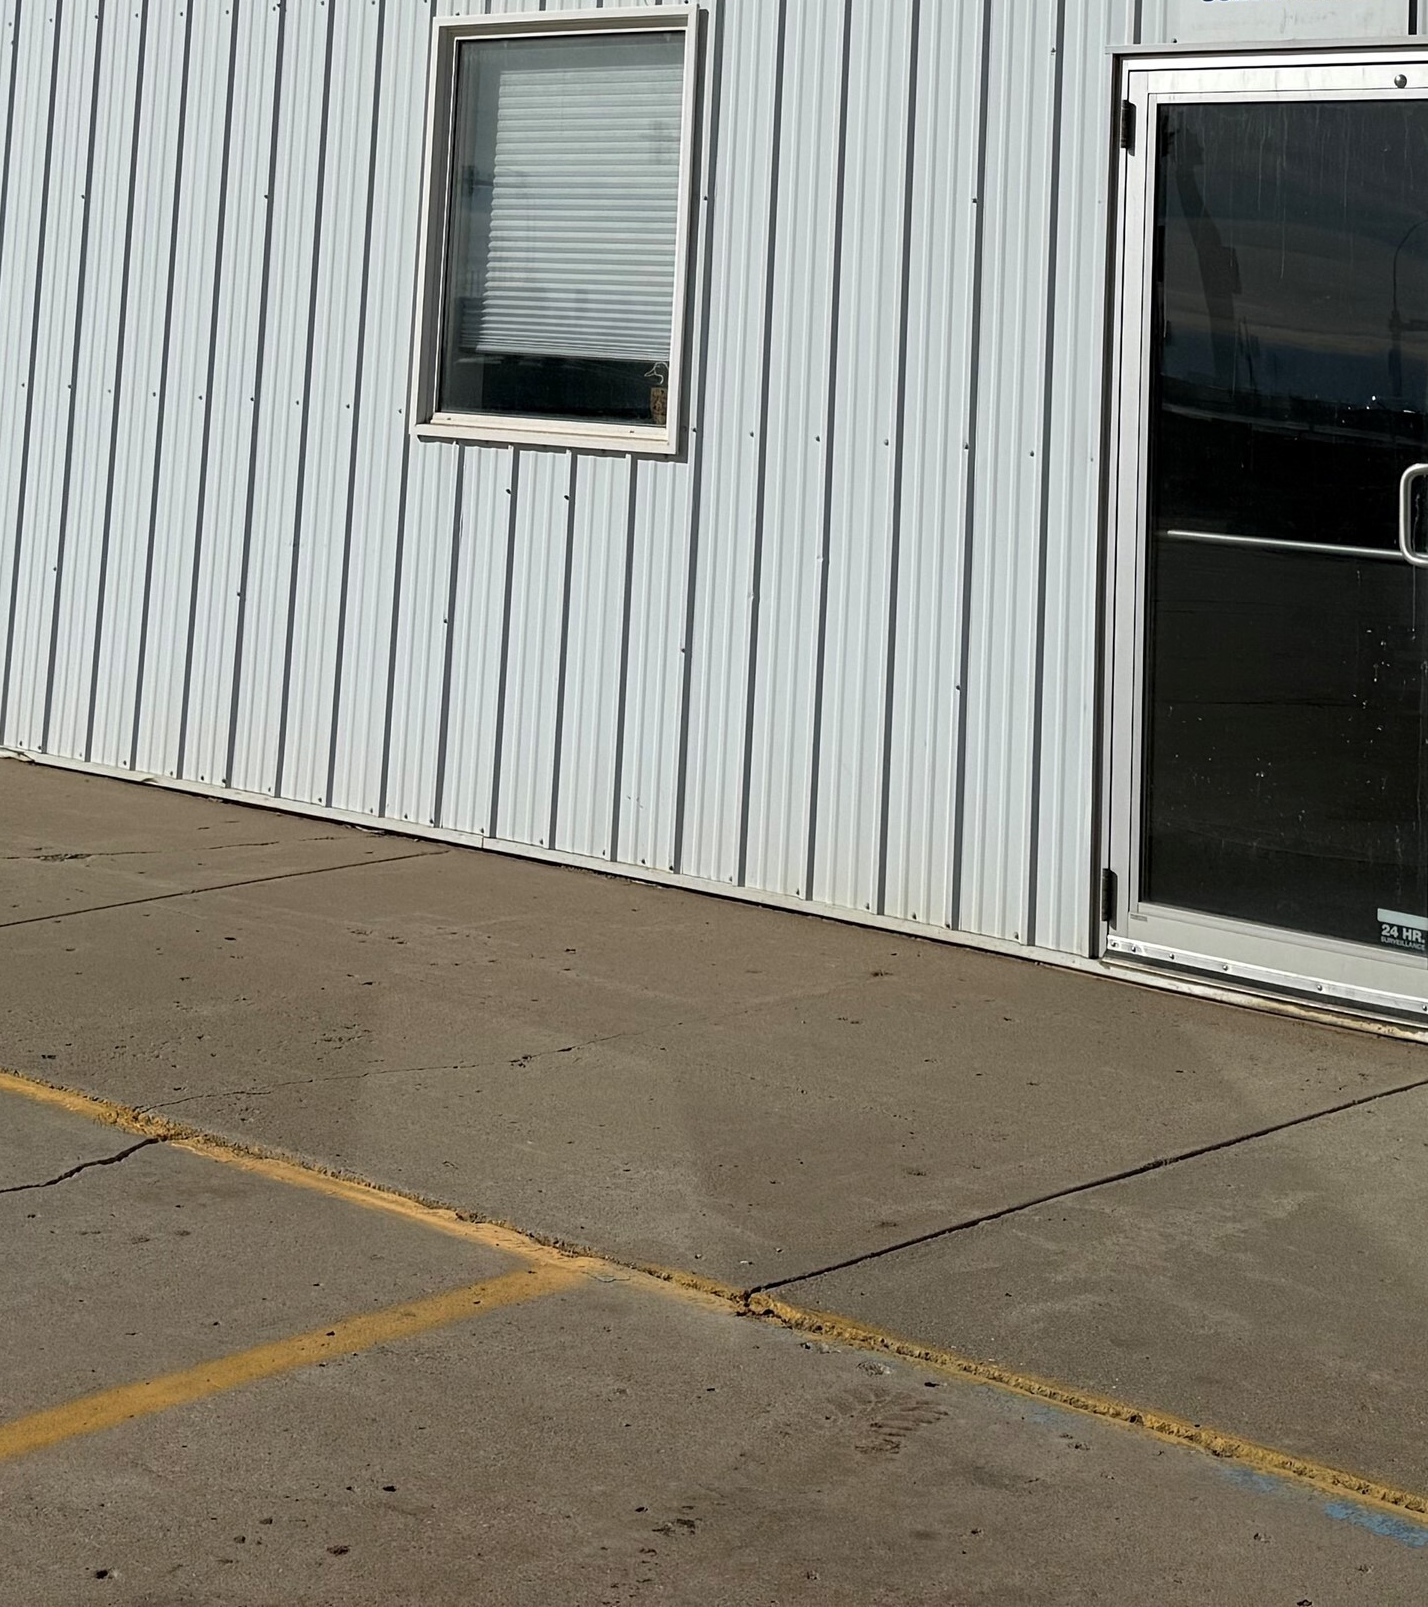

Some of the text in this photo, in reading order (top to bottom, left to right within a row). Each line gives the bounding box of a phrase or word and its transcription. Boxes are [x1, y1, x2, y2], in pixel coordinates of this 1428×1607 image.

[1381, 924, 1426, 944] 24 HR.
[1381, 935, 1426, 951] SURVEILLANCE
